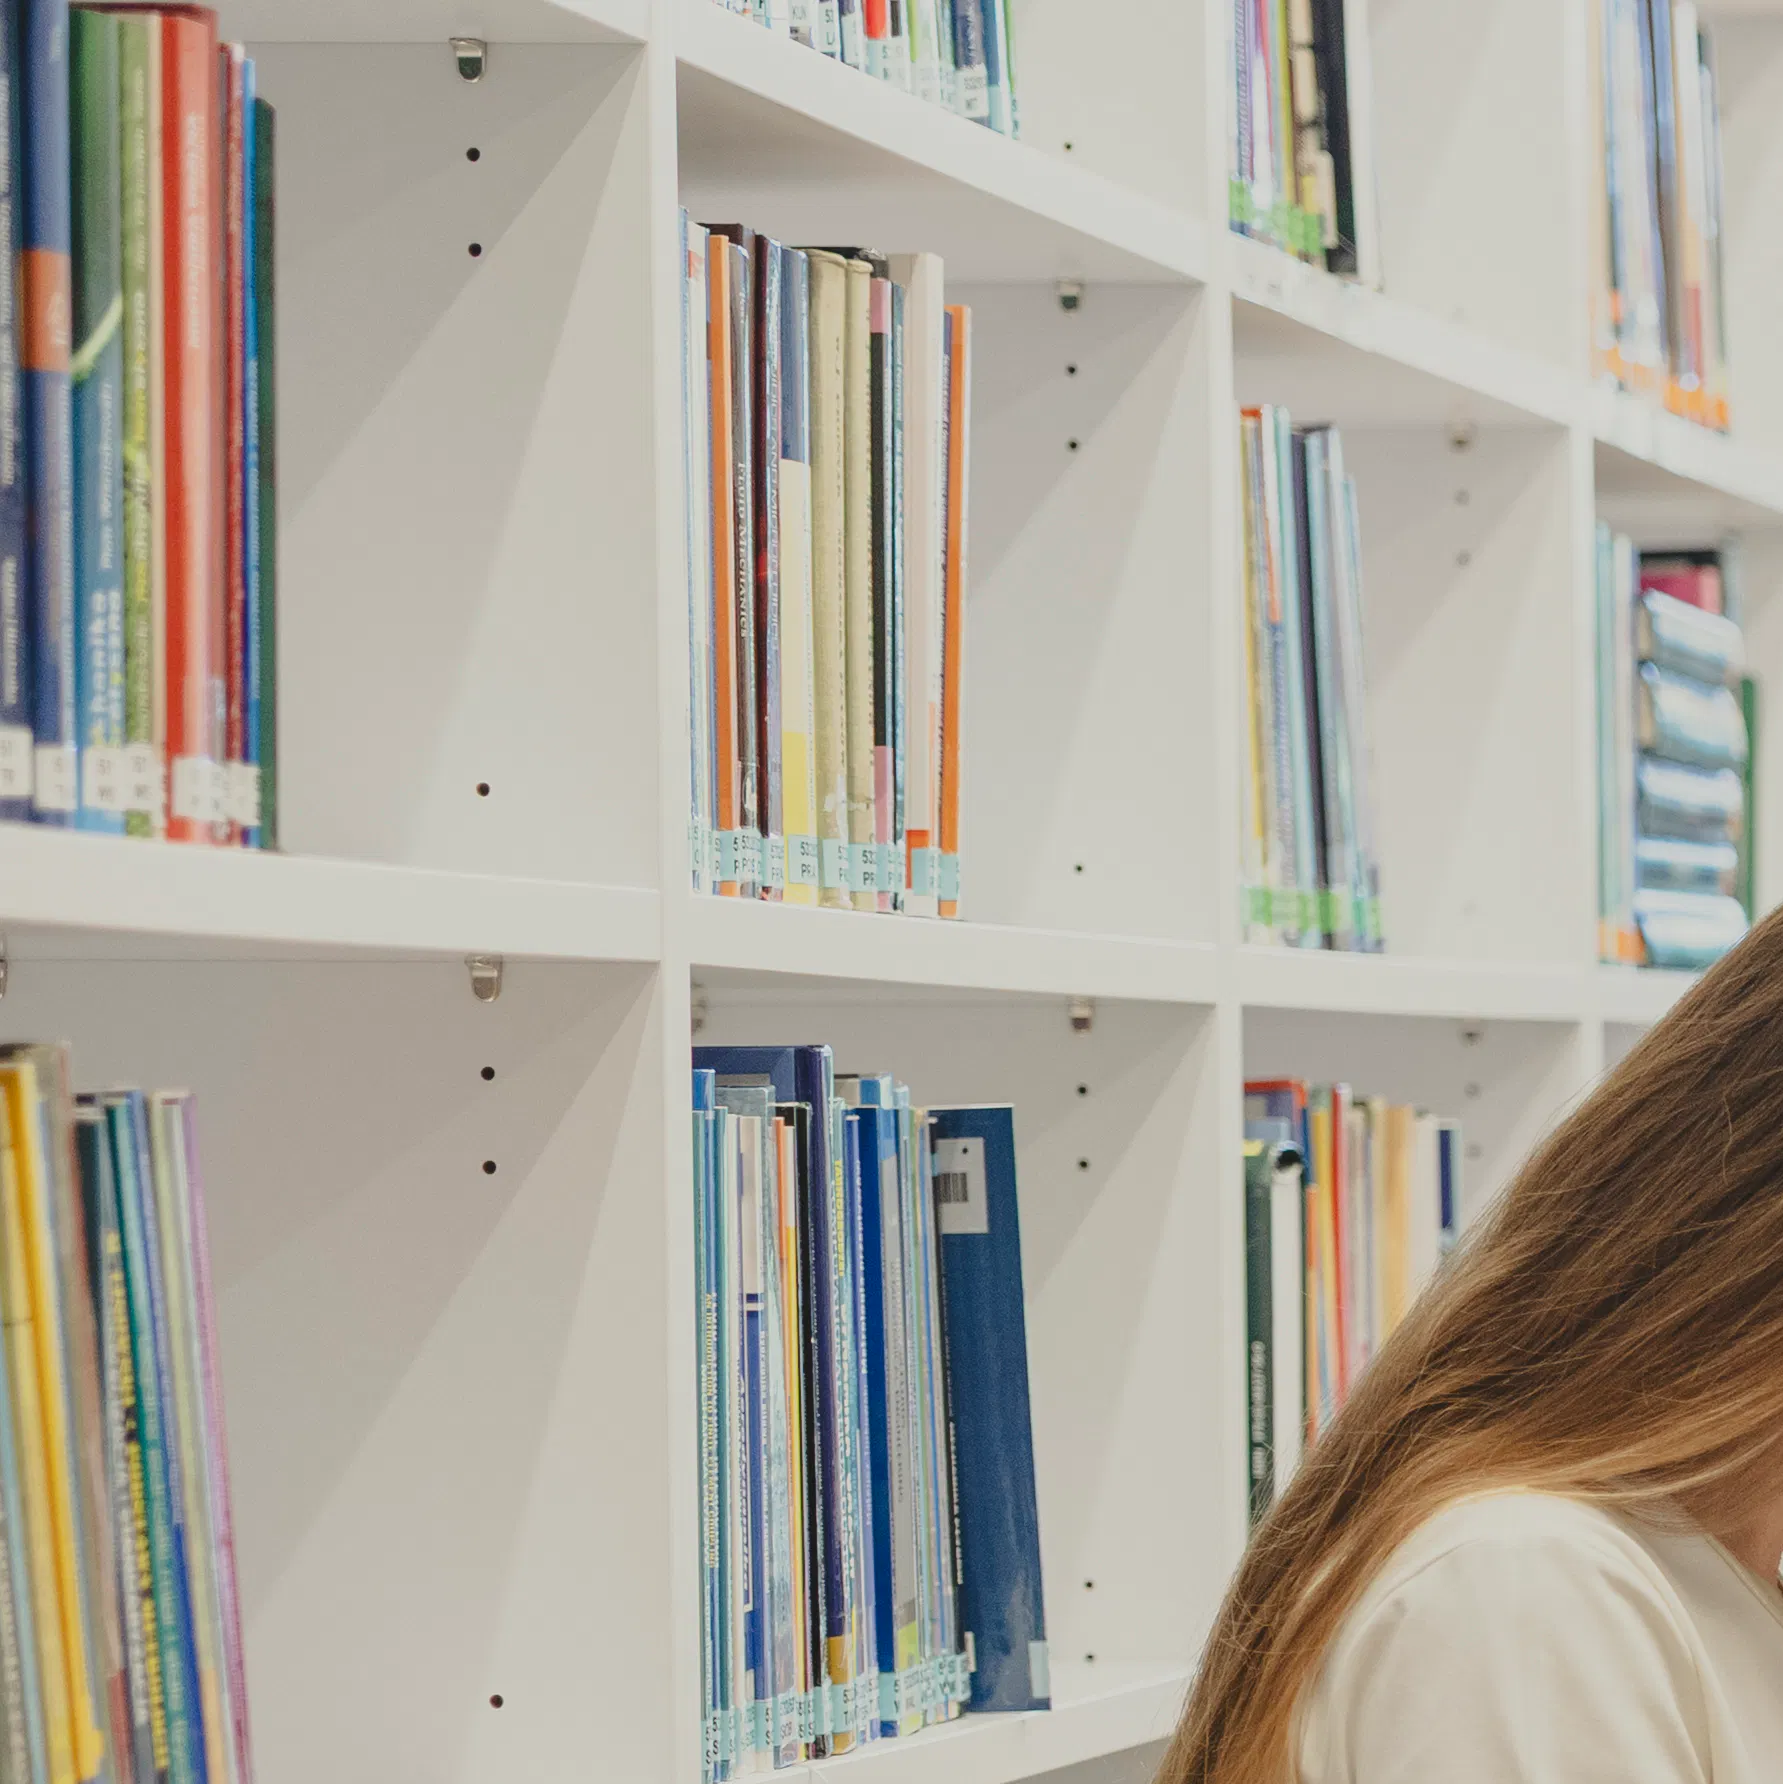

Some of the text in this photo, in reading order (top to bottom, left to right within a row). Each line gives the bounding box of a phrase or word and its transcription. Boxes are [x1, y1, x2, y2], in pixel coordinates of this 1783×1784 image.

[738, 463, 748, 638] FLUID MECHANICS
[856, 1159, 864, 1271] przepływów
[858, 1276, 868, 1374] Metrologia
